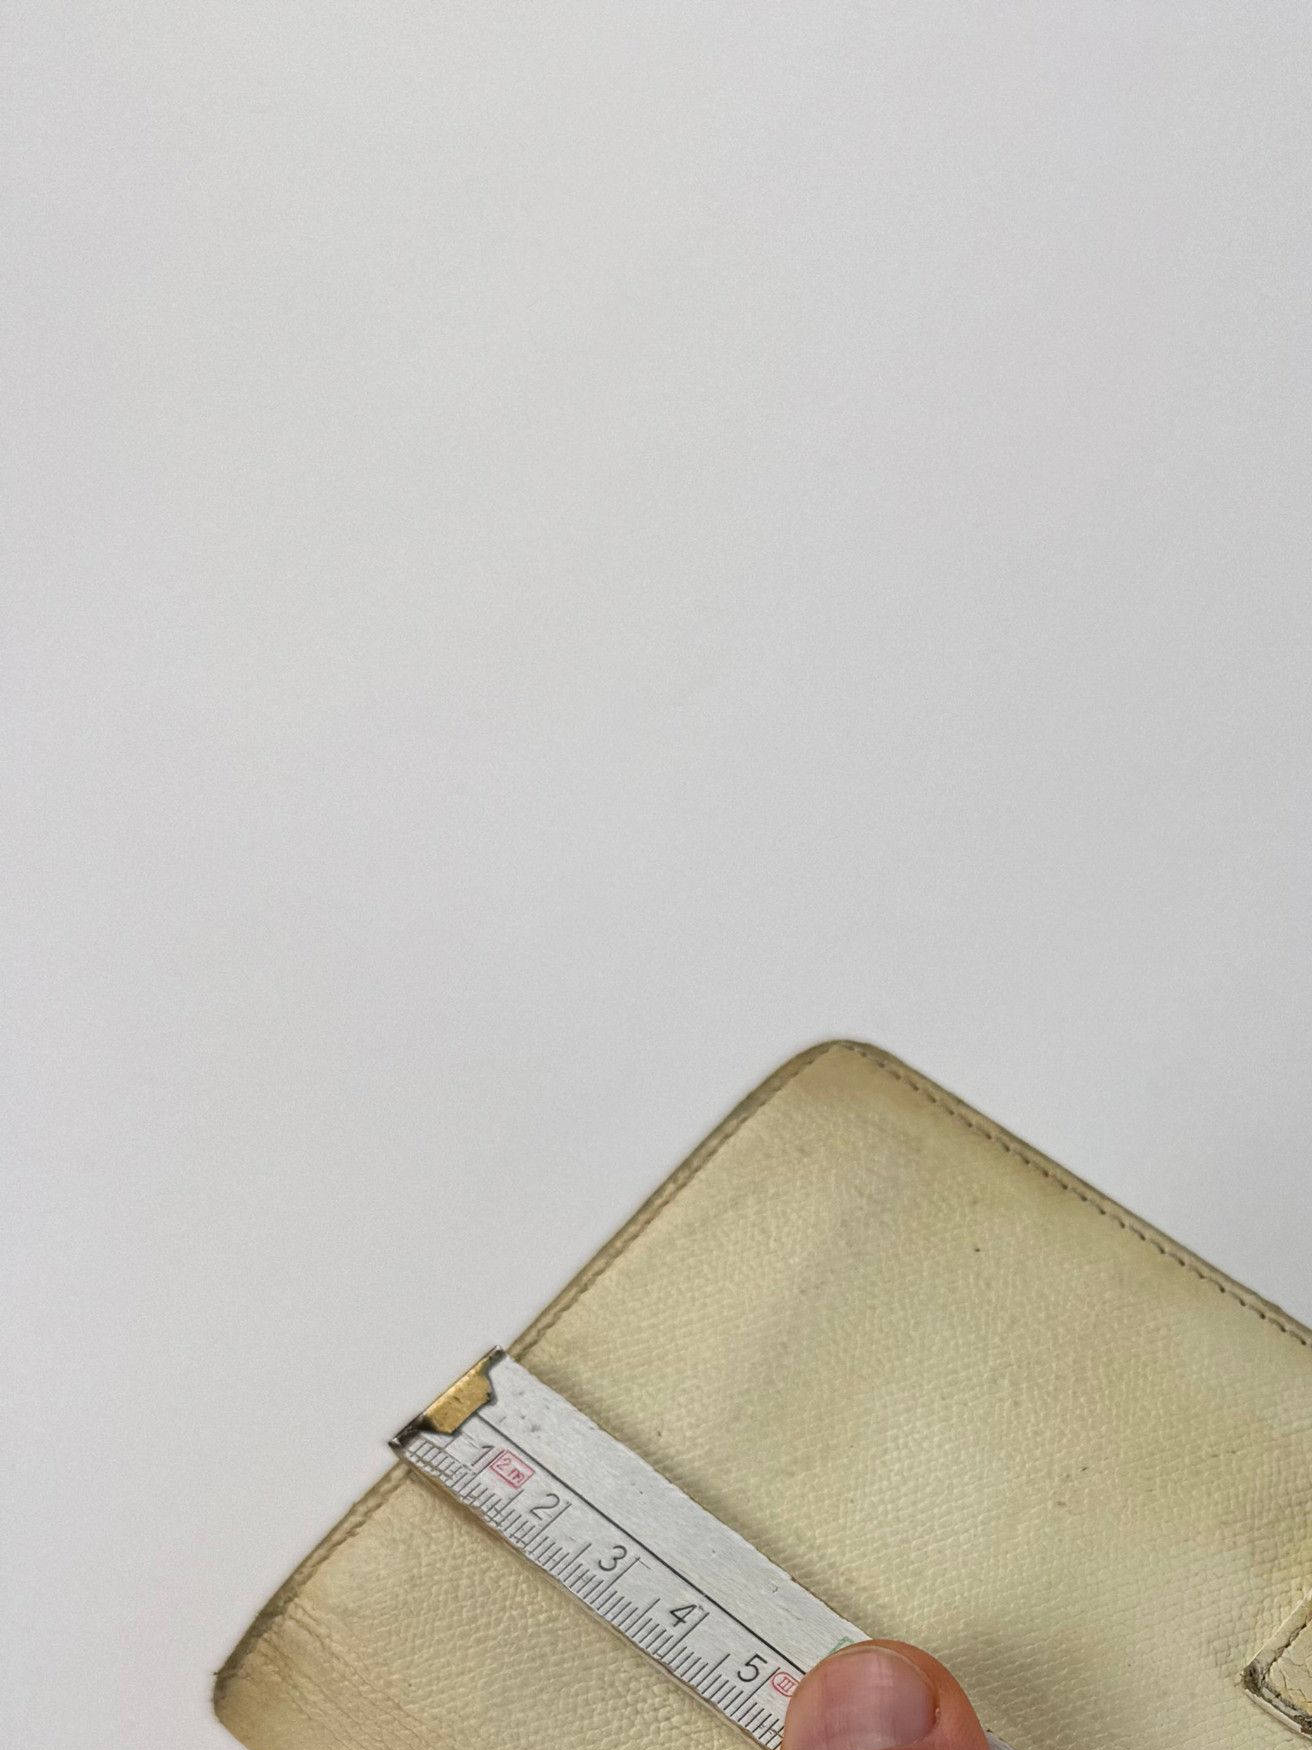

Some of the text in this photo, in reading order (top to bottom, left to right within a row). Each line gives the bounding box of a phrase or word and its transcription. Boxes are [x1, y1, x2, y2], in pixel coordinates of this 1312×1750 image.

[471, 1445, 495, 1467] 1
[530, 1493, 560, 1520] 2
[598, 1545, 627, 1571] 3
[670, 1603, 697, 1627] 4
[737, 1653, 768, 1682] 5
